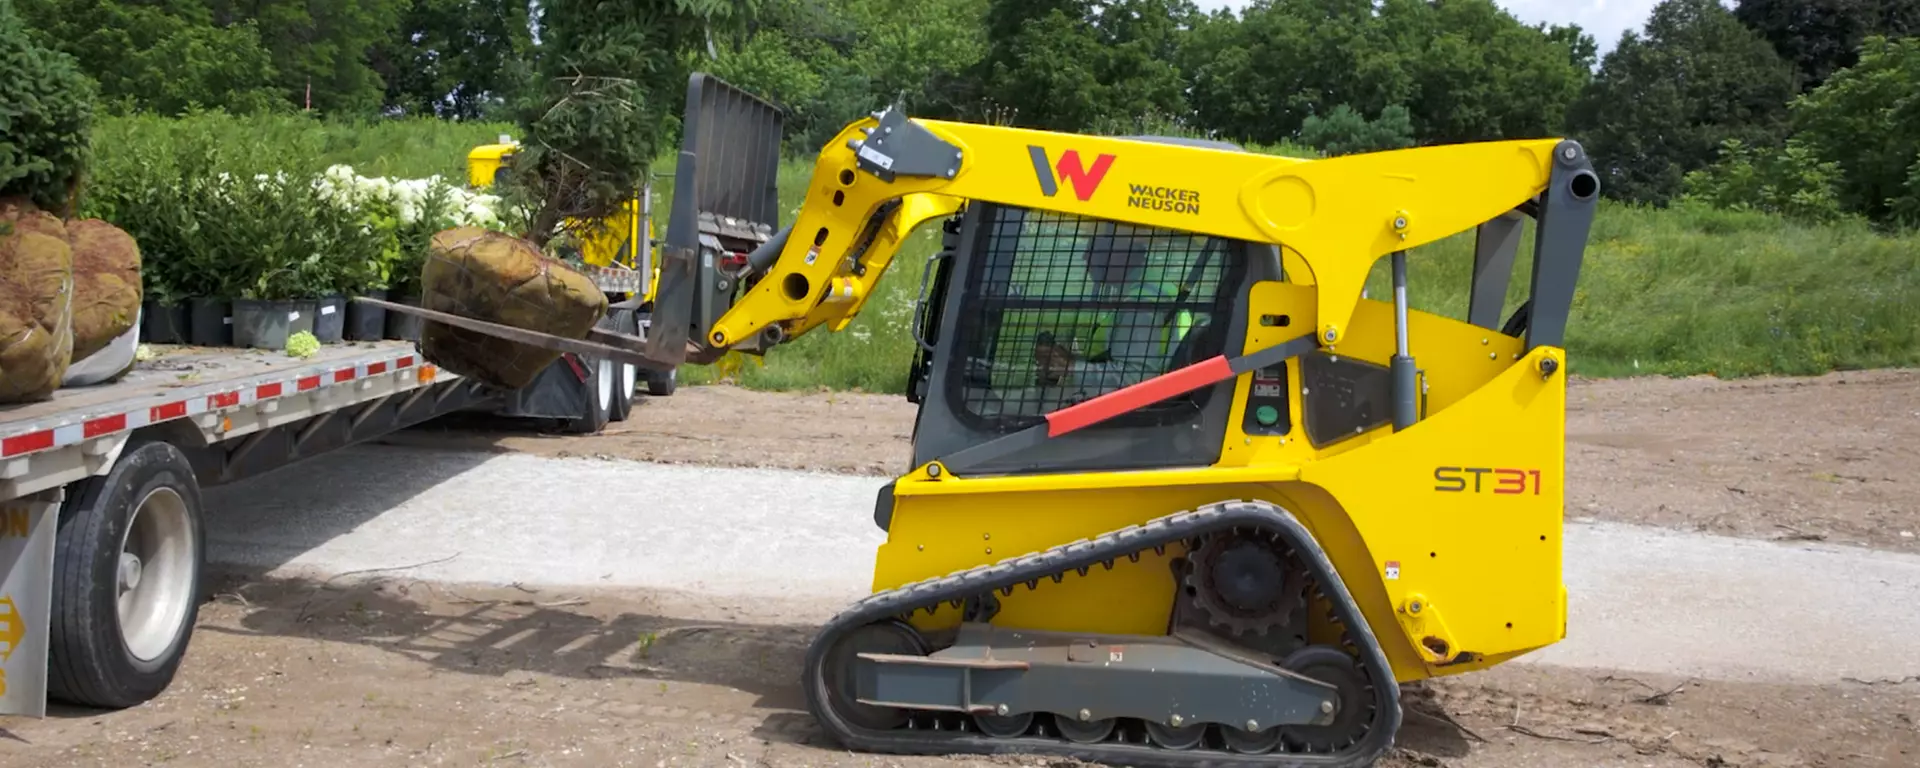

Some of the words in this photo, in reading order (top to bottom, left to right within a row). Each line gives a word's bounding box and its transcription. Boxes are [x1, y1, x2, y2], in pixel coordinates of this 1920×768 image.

[1129, 183, 1200, 202] WACKER
[1128, 196, 1200, 215] NEUSON
[1434, 466, 1540, 495] ST31
